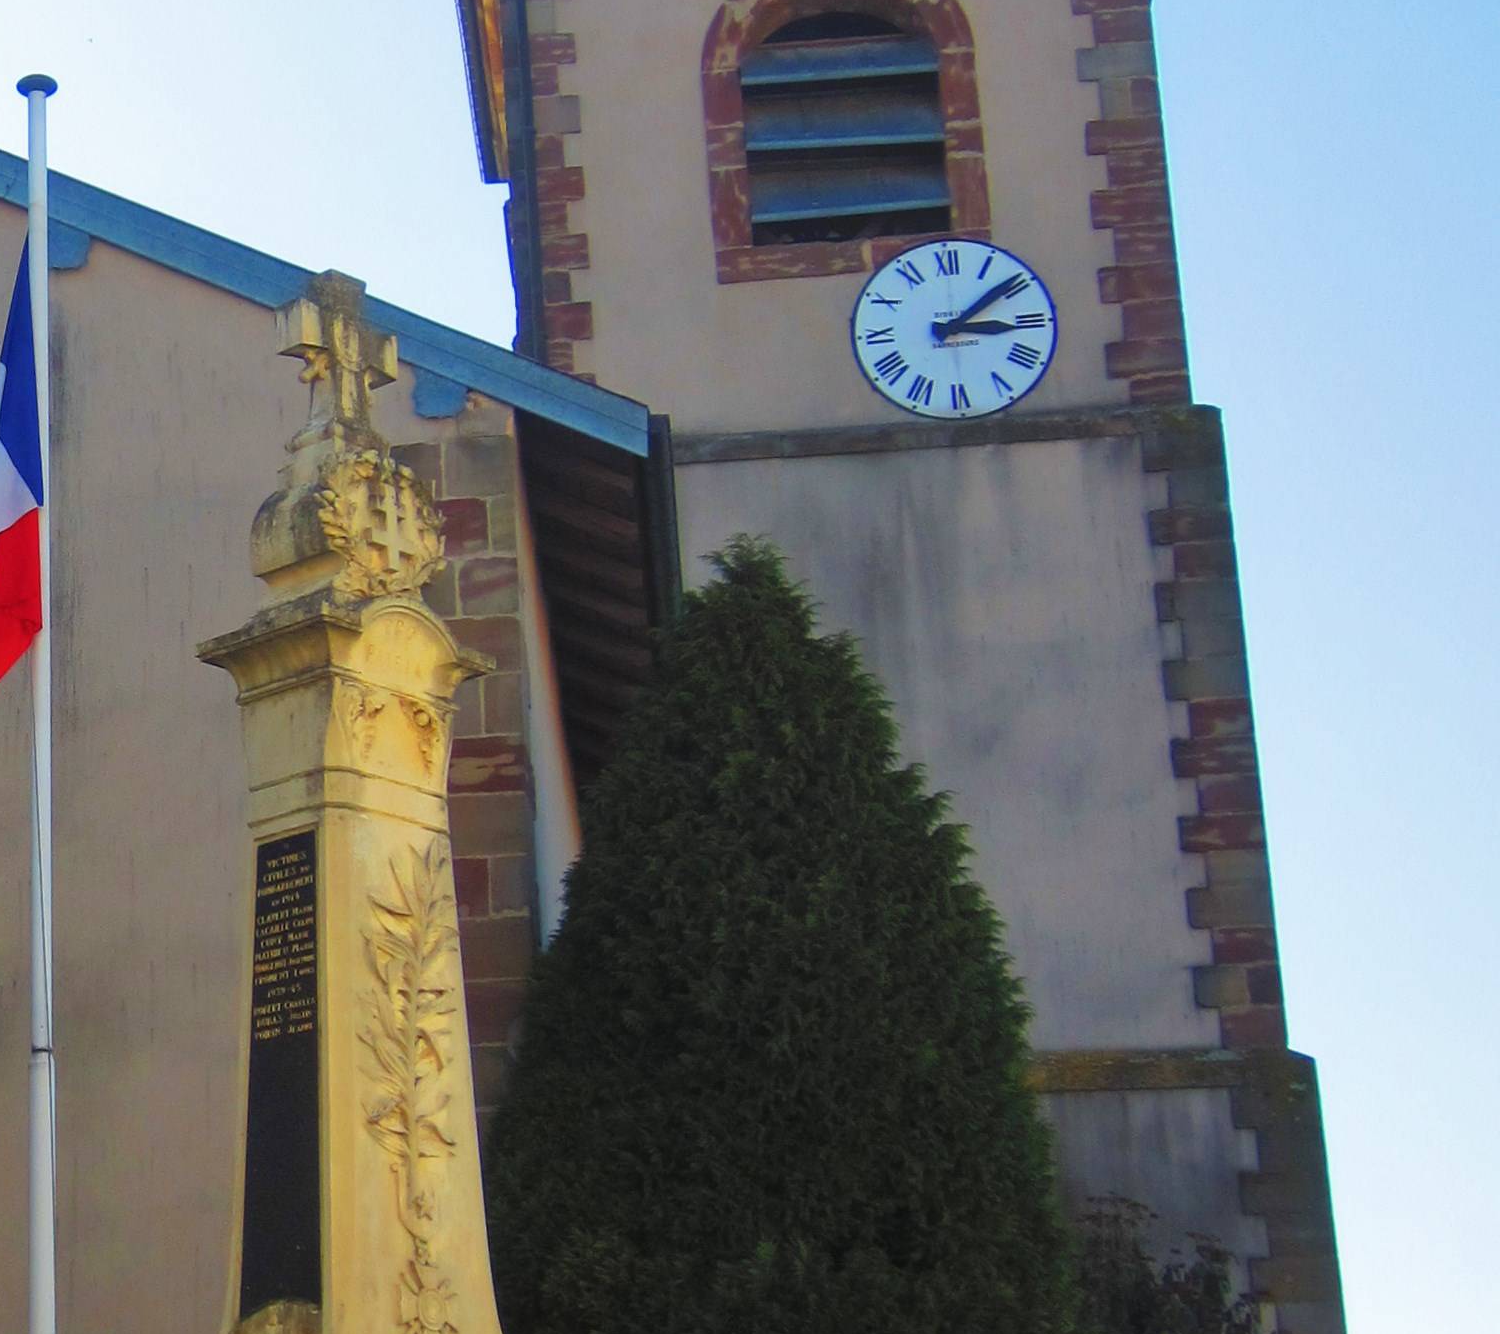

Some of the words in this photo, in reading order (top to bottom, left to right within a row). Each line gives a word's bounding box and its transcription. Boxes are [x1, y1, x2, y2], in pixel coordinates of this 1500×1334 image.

[934, 249, 960, 277] XII
[978, 255, 993, 280] I
[895, 260, 926, 290] XI
[870, 292, 902, 312] X
[1015, 313, 1046, 329] III
[263, 866, 297, 884] CIVILES
